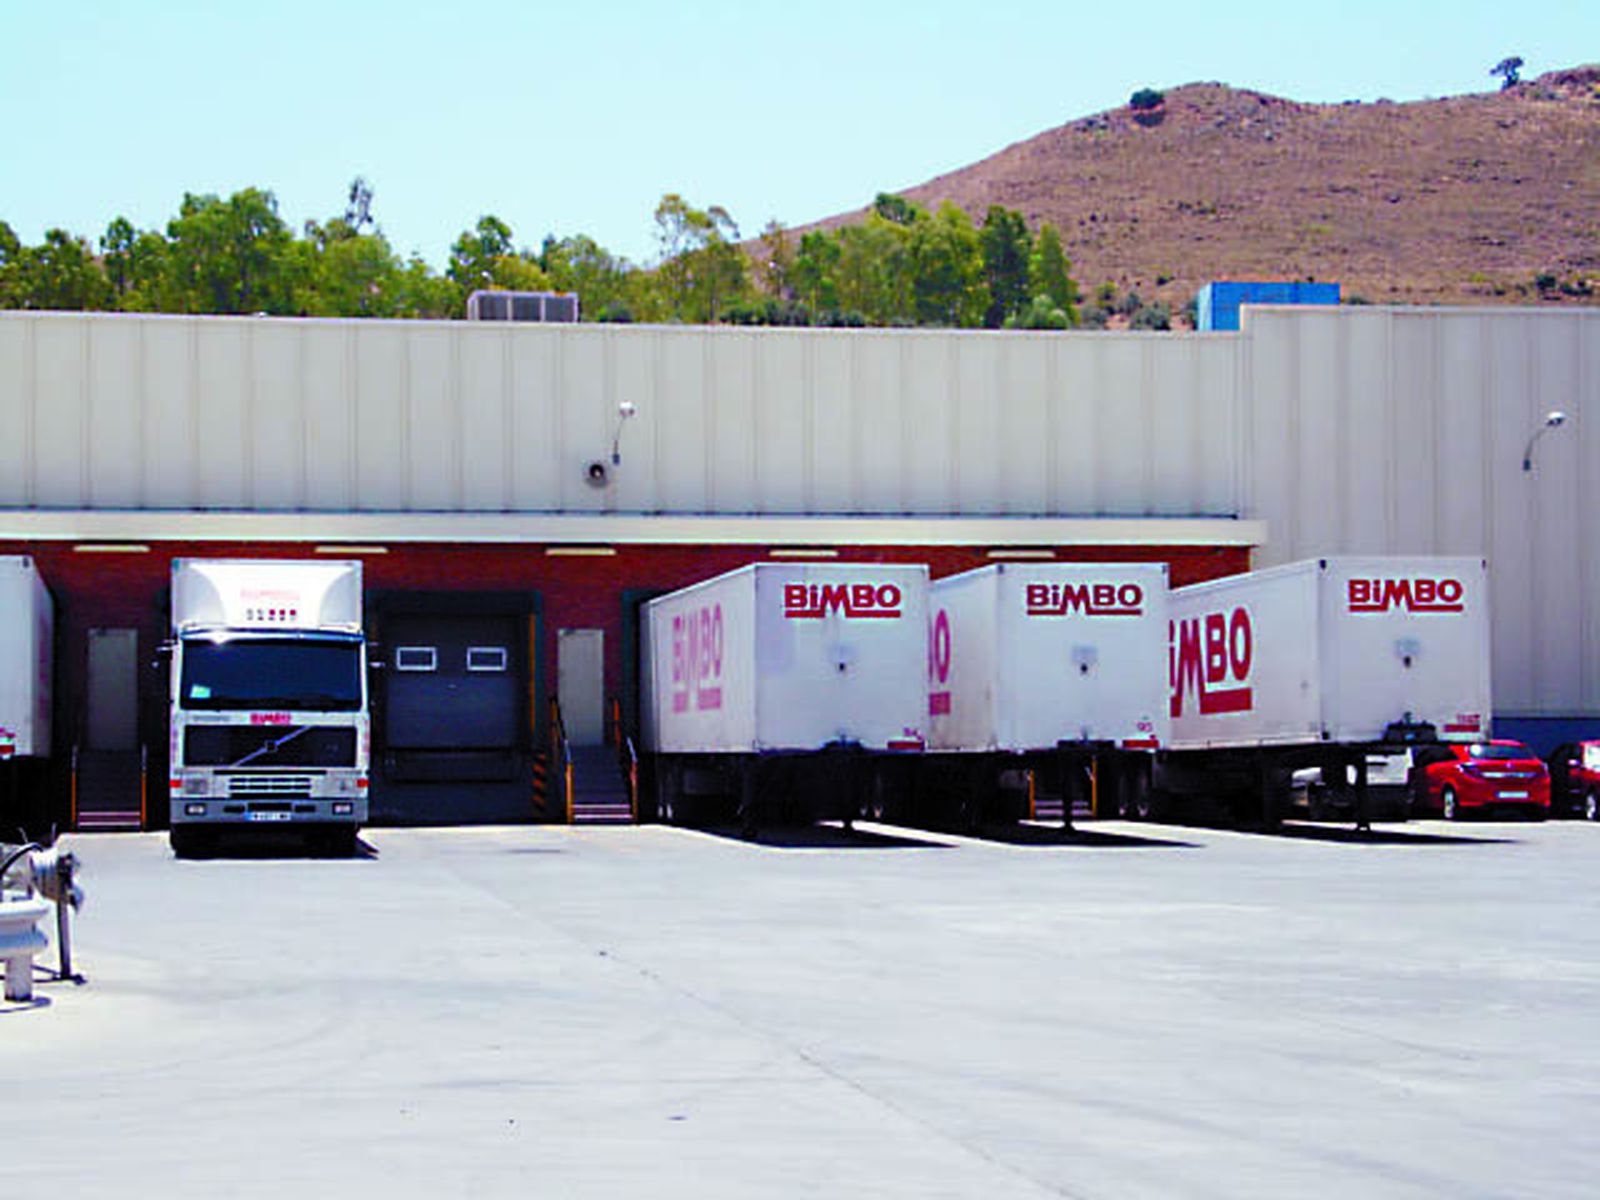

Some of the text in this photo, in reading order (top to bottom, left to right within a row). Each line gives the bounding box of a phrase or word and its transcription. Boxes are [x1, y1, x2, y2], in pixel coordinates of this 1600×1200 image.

[785, 584, 901, 618] BiMBO
[1026, 584, 1142, 615] BiMBO
[1349, 579, 1463, 612] BiMBO
[1169, 606, 1252, 718] iMBO
